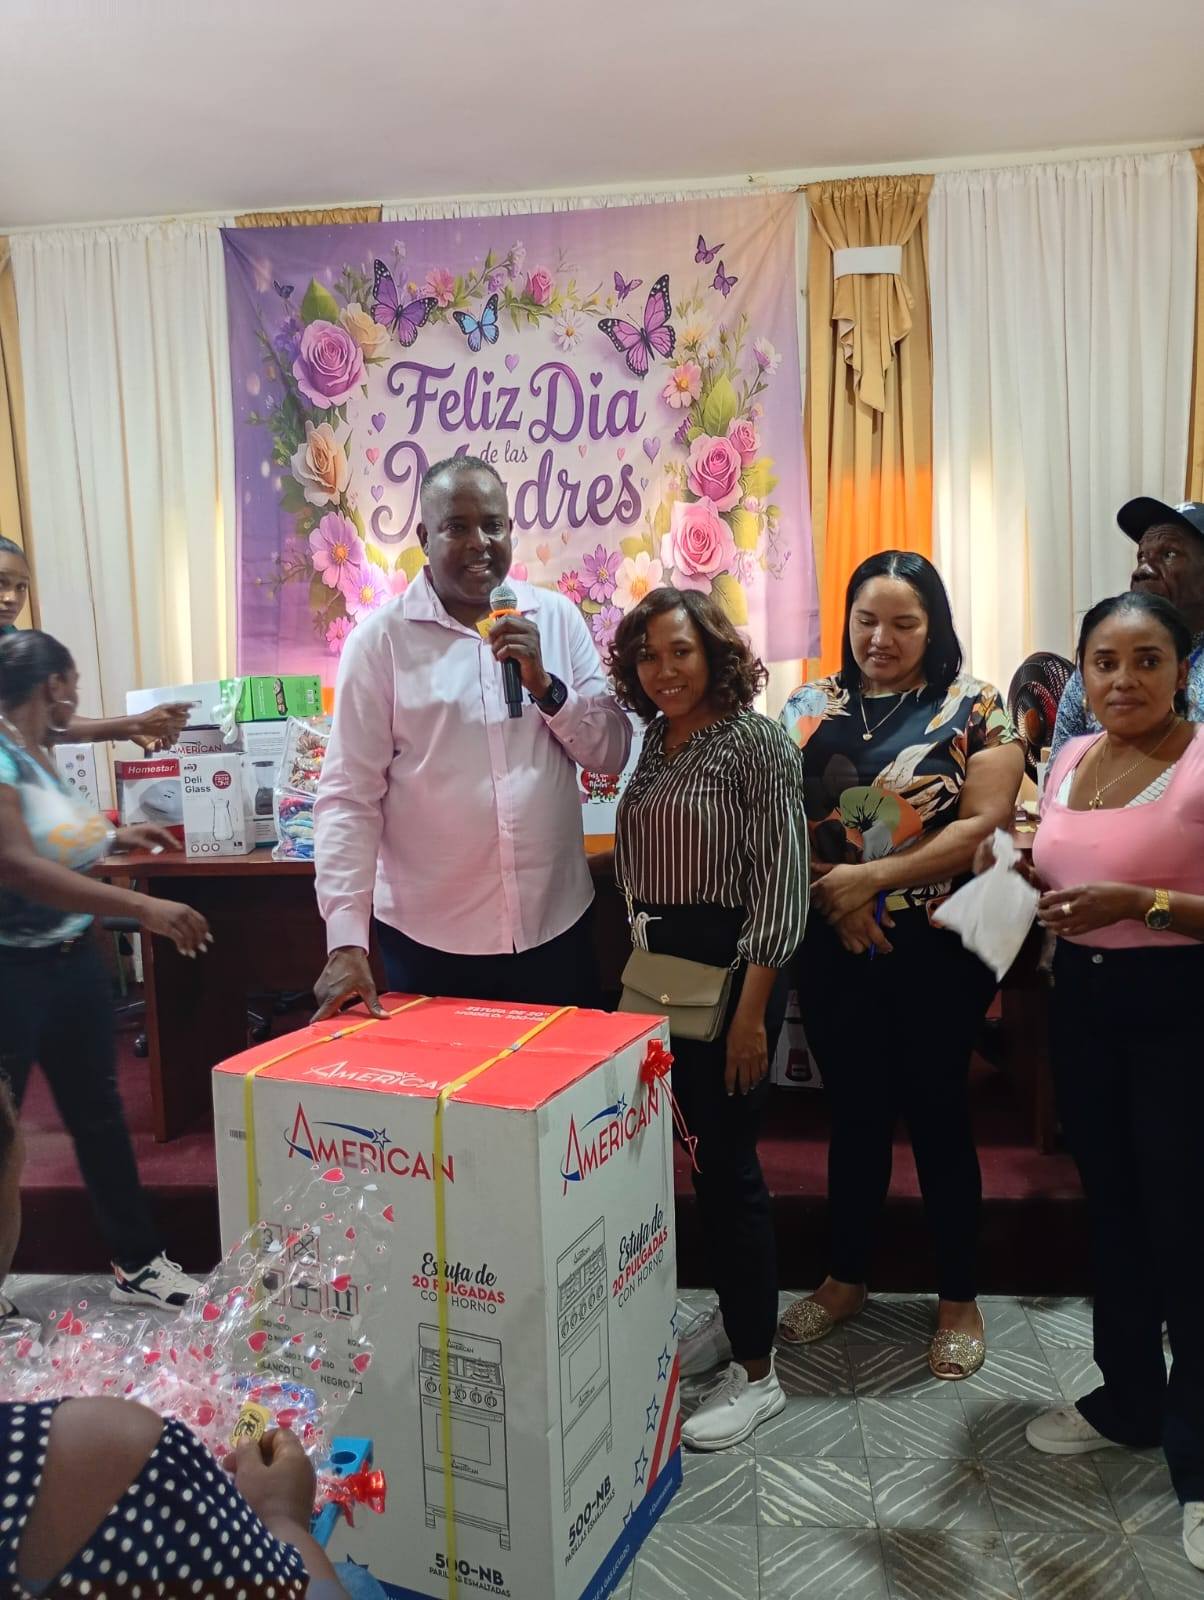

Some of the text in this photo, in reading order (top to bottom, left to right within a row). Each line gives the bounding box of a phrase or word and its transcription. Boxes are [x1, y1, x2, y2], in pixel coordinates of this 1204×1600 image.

[387, 361, 646, 444] Feliz Dia
[480, 440, 528, 464] de las
[127, 764, 175, 775] Homestar
[184, 776, 202, 784] Deli
[185, 786, 211, 794] Glass
[563, 1087, 659, 1197] AMERICAN
[618, 1203, 664, 1272] Estufa de
[613, 1225, 668, 1298] 20 PULGADAS
[412, 1274, 429, 1289] 20
[475, 1263, 497, 1287] de
[618, 1249, 664, 1308] CON HORNO
[451, 1296, 497, 1314] HORNO
[320, 1375, 351, 1389] NEGRO
[569, 1475, 612, 1548] 500-NB
[464, 1577, 511, 1598] ESMALTADAS
